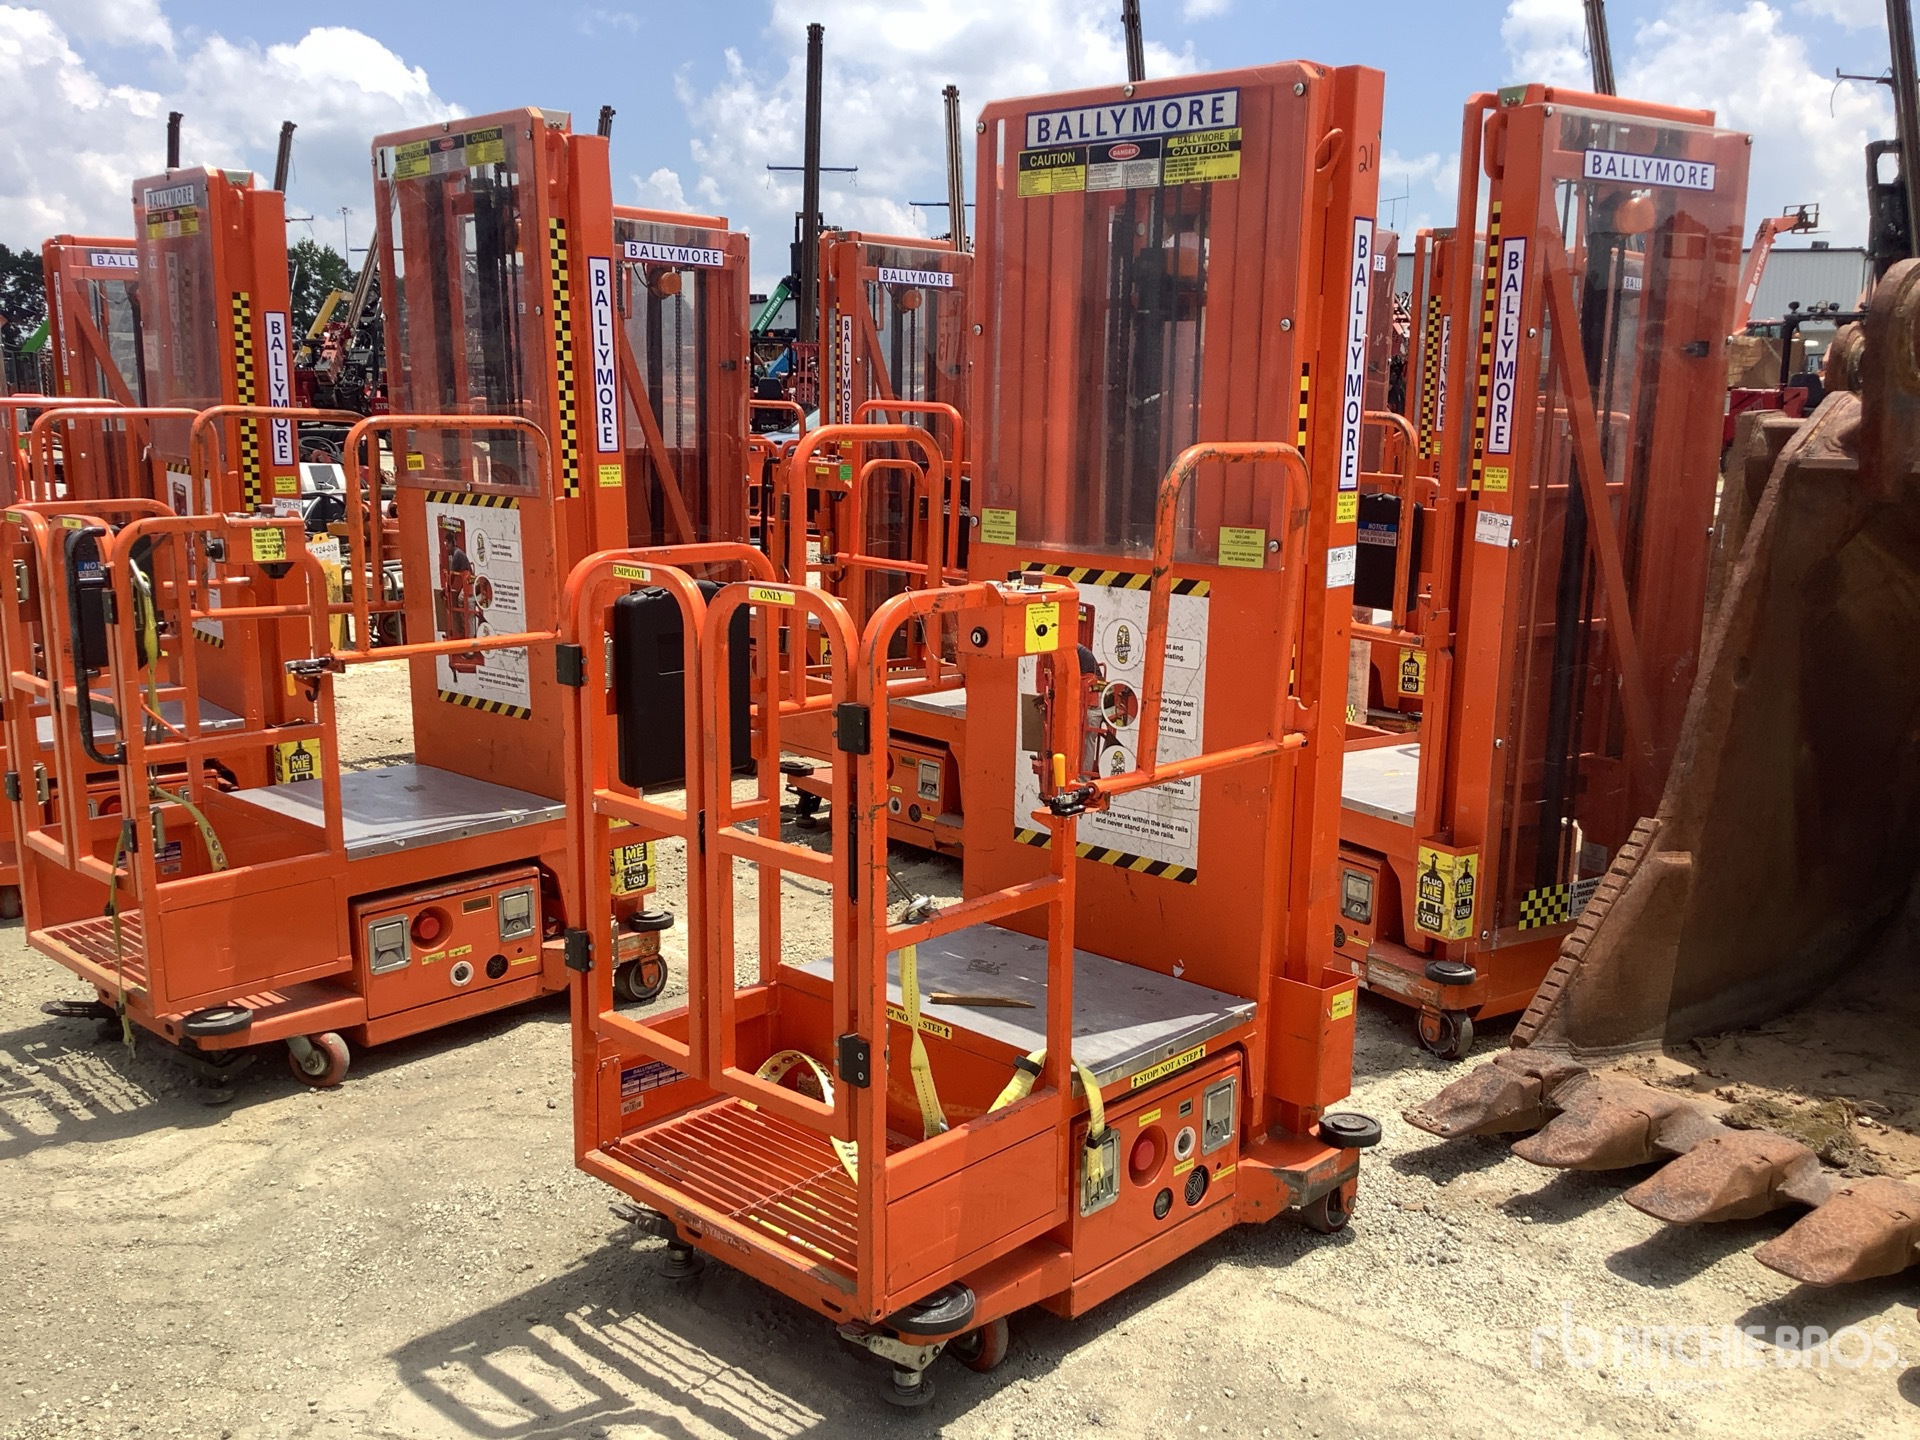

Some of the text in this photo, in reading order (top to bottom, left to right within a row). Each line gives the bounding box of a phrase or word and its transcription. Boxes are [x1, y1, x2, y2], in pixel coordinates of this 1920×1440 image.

[1037, 96, 1225, 143] BALLYMORE
[1177, 132, 1225, 145] BALLYMORE
[1172, 142, 1230, 156] CAUTION
[1029, 152, 1076, 167] CAUTION
[1358, 143, 1374, 174] 21
[1592, 154, 1708, 187] BALLYMORE
[148, 187, 192, 209] BALLYMORE
[630, 244, 719, 264] BALLYMORE
[882, 269, 950, 286] BALLYMORE
[1495, 251, 1520, 444] BALLYMORE
[595, 268, 614, 444] BALLYMORE
[1345, 234, 1368, 478] BALLYMORE
[760, 590, 782, 601] ONLY
[1168, 698, 1182, 707] body
[1170, 708, 1191, 717] lanyard
[292, 760, 310, 769] ME
[1163, 785, 1185, 795] lanyard.
[1124, 822, 1140, 831] stand
[1160, 831, 1175, 839] rails.
[1133, 815, 1150, 824] within
[1175, 824, 1188, 833] rails
[626, 847, 644, 860] ME
[628, 874, 645, 885] YOU
[1423, 876, 1442, 887] PLUG
[1576, 880, 1599, 889] MANUAL
[1422, 884, 1441, 898] ME
[1458, 884, 1472, 893] ME
[1457, 907, 1470, 916] YOU
[1421, 913, 1440, 926] YOU
[923, 1020, 942, 1033] STEP
[1139, 1070, 1159, 1084] STOP!
[1160, 1064, 1174, 1074] NOT
[1182, 1052, 1198, 1064] STEP
